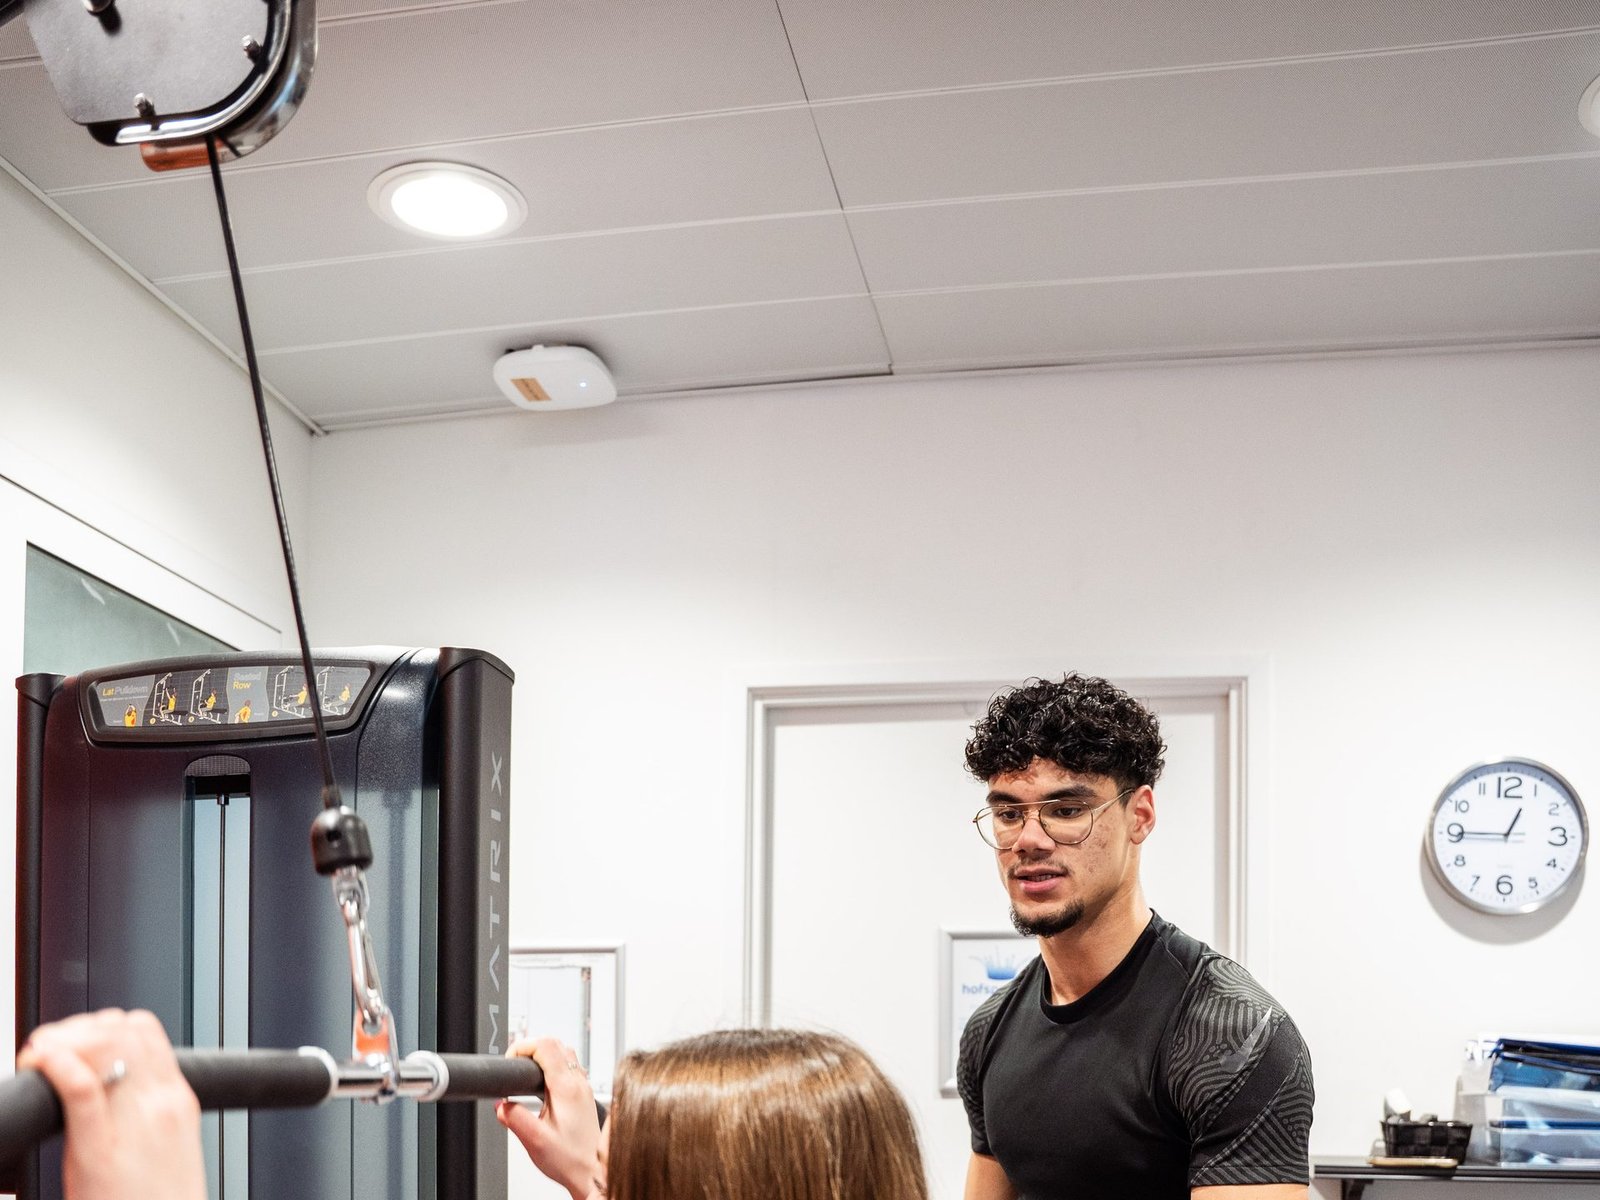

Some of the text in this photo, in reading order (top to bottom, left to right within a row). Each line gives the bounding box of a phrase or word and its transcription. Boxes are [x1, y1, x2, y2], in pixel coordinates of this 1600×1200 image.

[103, 687, 115, 696] Lat
[233, 681, 252, 689] Row
[1497, 776, 1523, 799] 12
[1454, 799, 1470, 813] 10
[1548, 802, 1560, 816] 2
[1447, 822, 1464, 844] 9
[1547, 826, 1568, 847] 3
[1454, 854, 1466, 867] 8
[1546, 858, 1557, 869] 4
[1471, 874, 1481, 887] 7
[1496, 874, 1514, 896] 6
[1528, 876, 1539, 889] 5
[489, 751, 503, 1055] MATRIX
